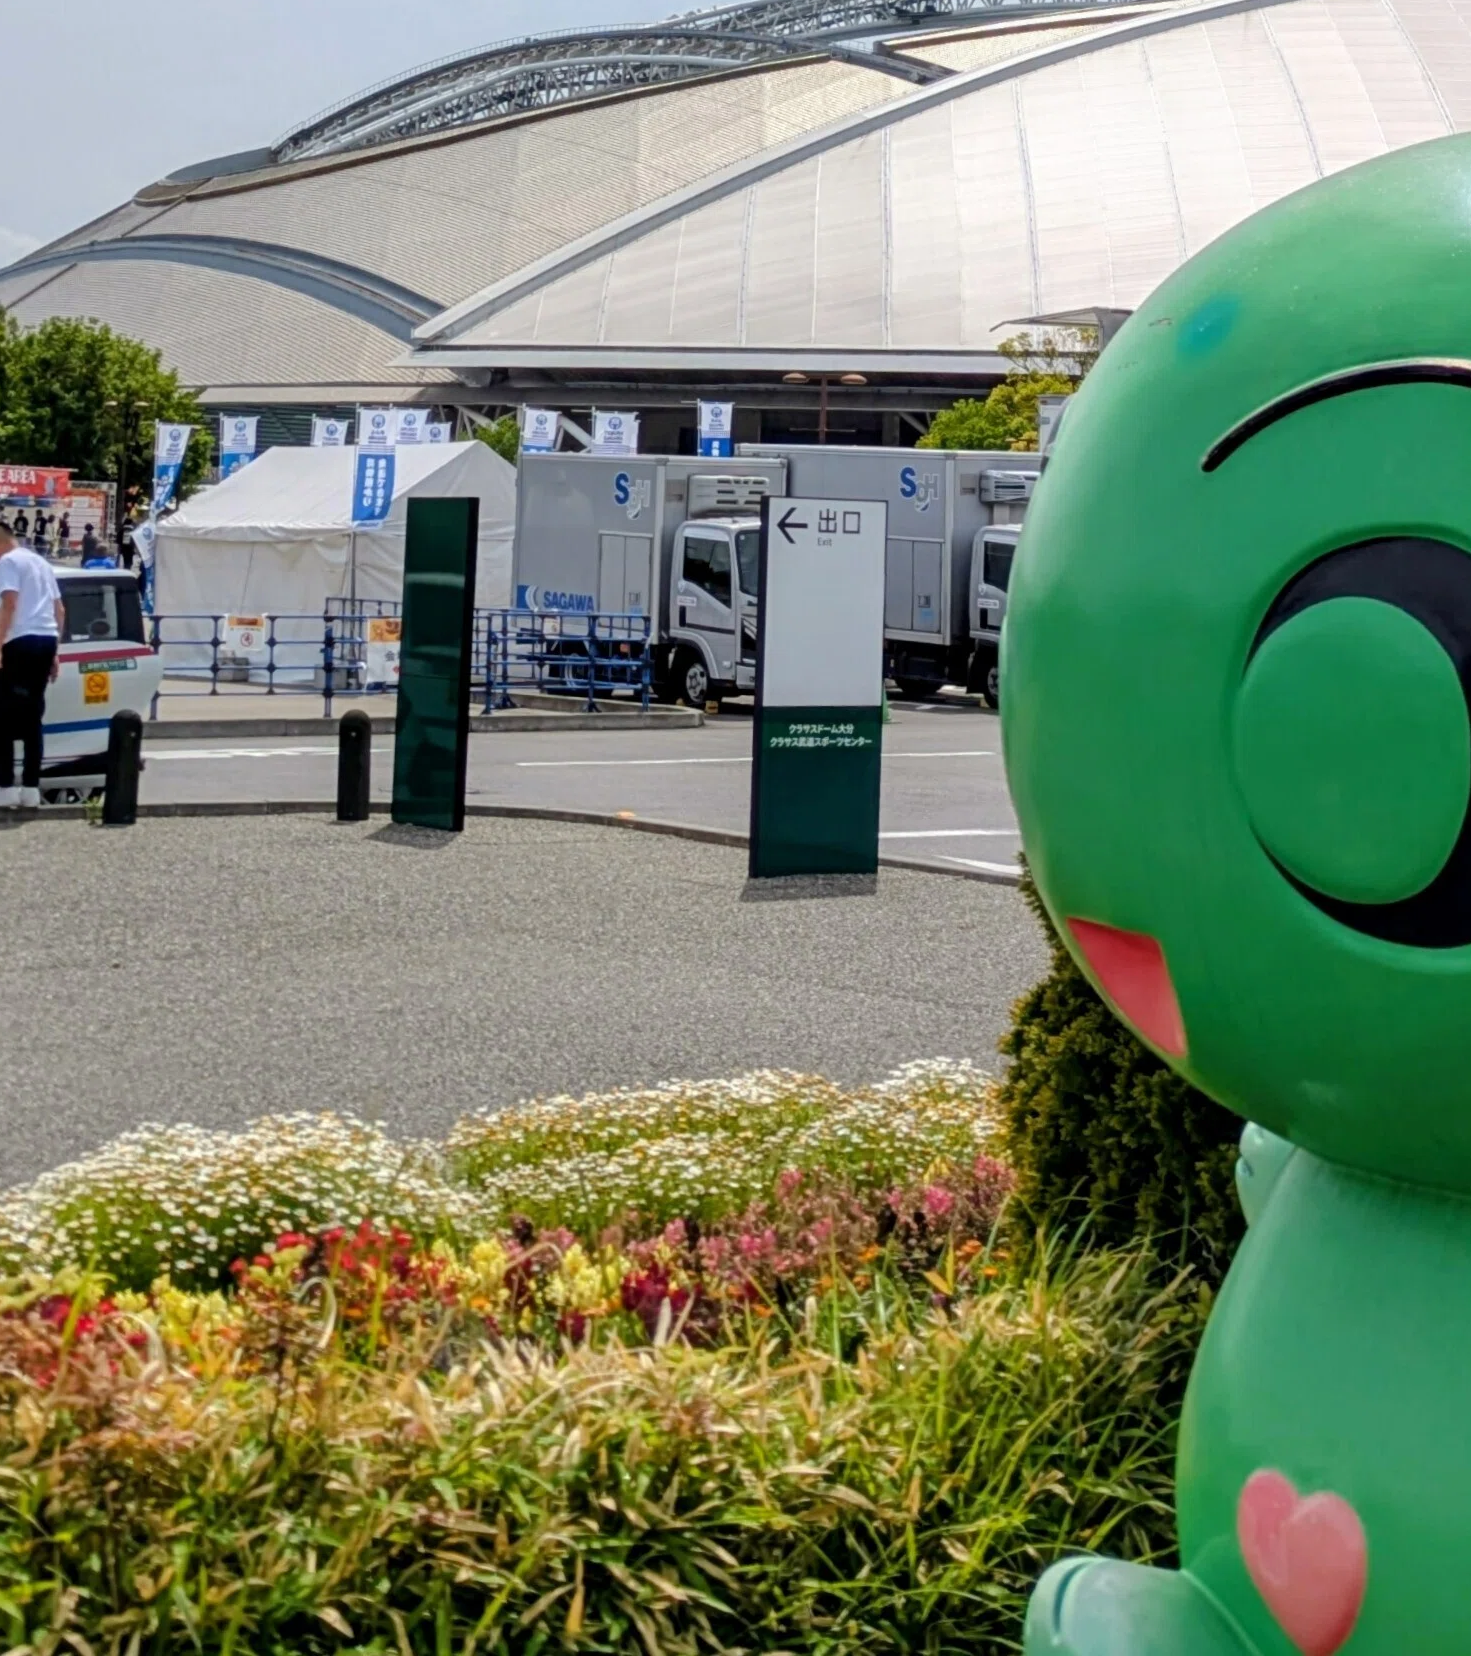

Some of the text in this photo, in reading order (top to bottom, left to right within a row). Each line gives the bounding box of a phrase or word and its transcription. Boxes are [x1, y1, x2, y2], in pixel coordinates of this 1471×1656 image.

[7, 469, 37, 485] AREA
[818, 508, 861, 534] 出口
[817, 537, 832, 547] Exit
[543, 590, 595, 612] SAGAWA
[789, 723, 855, 734] クラサスドーム大分
